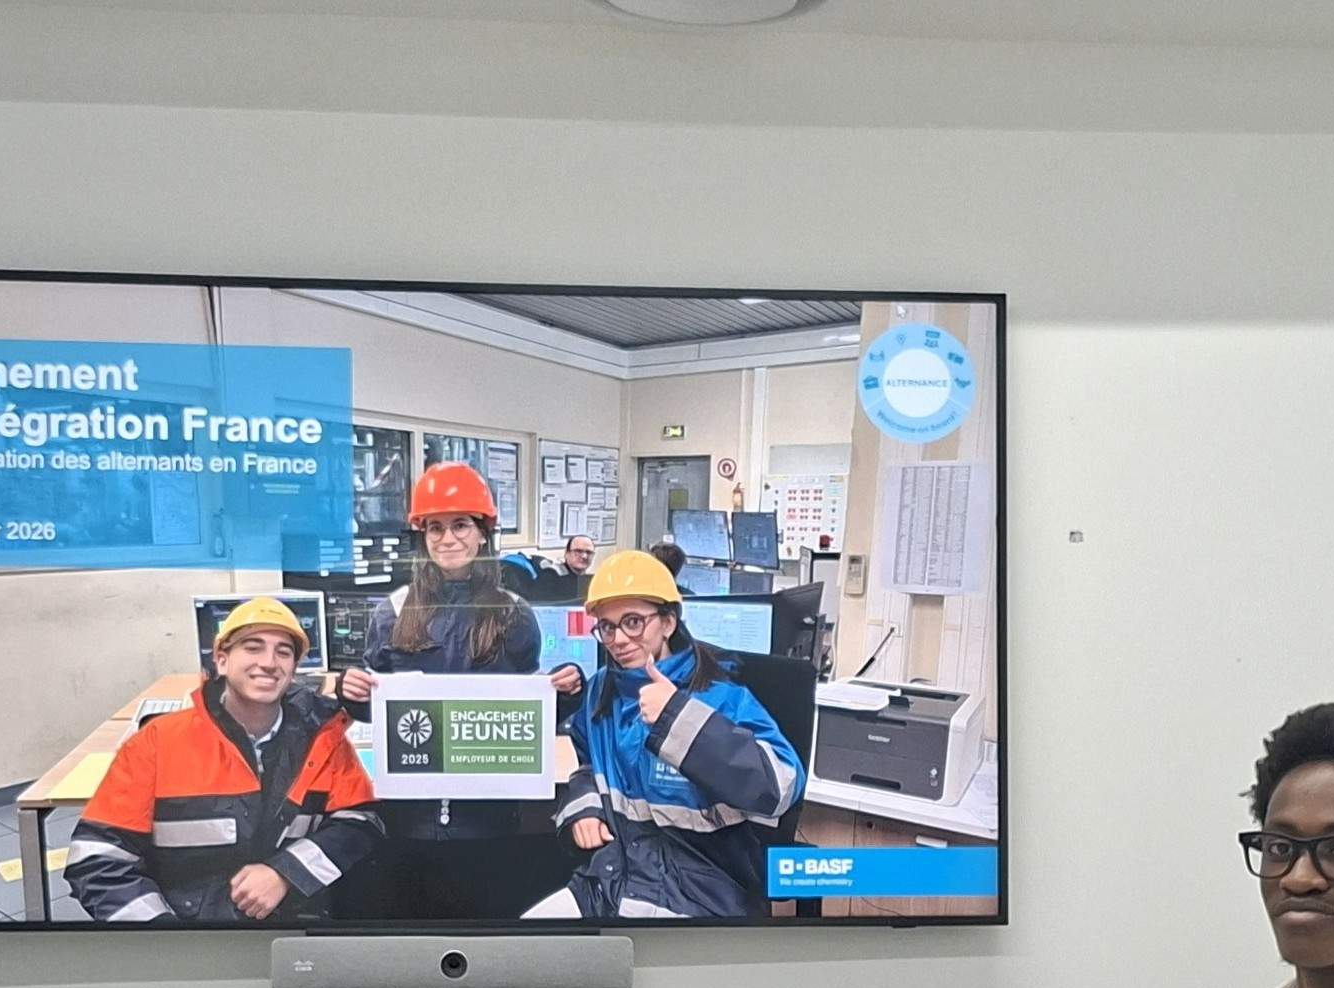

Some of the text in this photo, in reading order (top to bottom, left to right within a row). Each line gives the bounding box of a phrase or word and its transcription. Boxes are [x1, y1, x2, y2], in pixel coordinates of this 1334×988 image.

[886, 379, 948, 388] ALTERNANCE
[183, 408, 323, 444] France
[51, 450, 91, 470] des
[96, 452, 204, 473] alternants
[210, 457, 237, 474] en
[242, 453, 317, 475] France
[6, 521, 56, 541] 2026
[450, 710, 536, 722] ENGAGEMENT
[450, 723, 536, 741] JEUNES
[401, 753, 429, 765] 2025
[450, 755, 496, 763] EMPLOYEUR
[498, 755, 508, 763] DE
[804, 858, 854, 875] BASF
